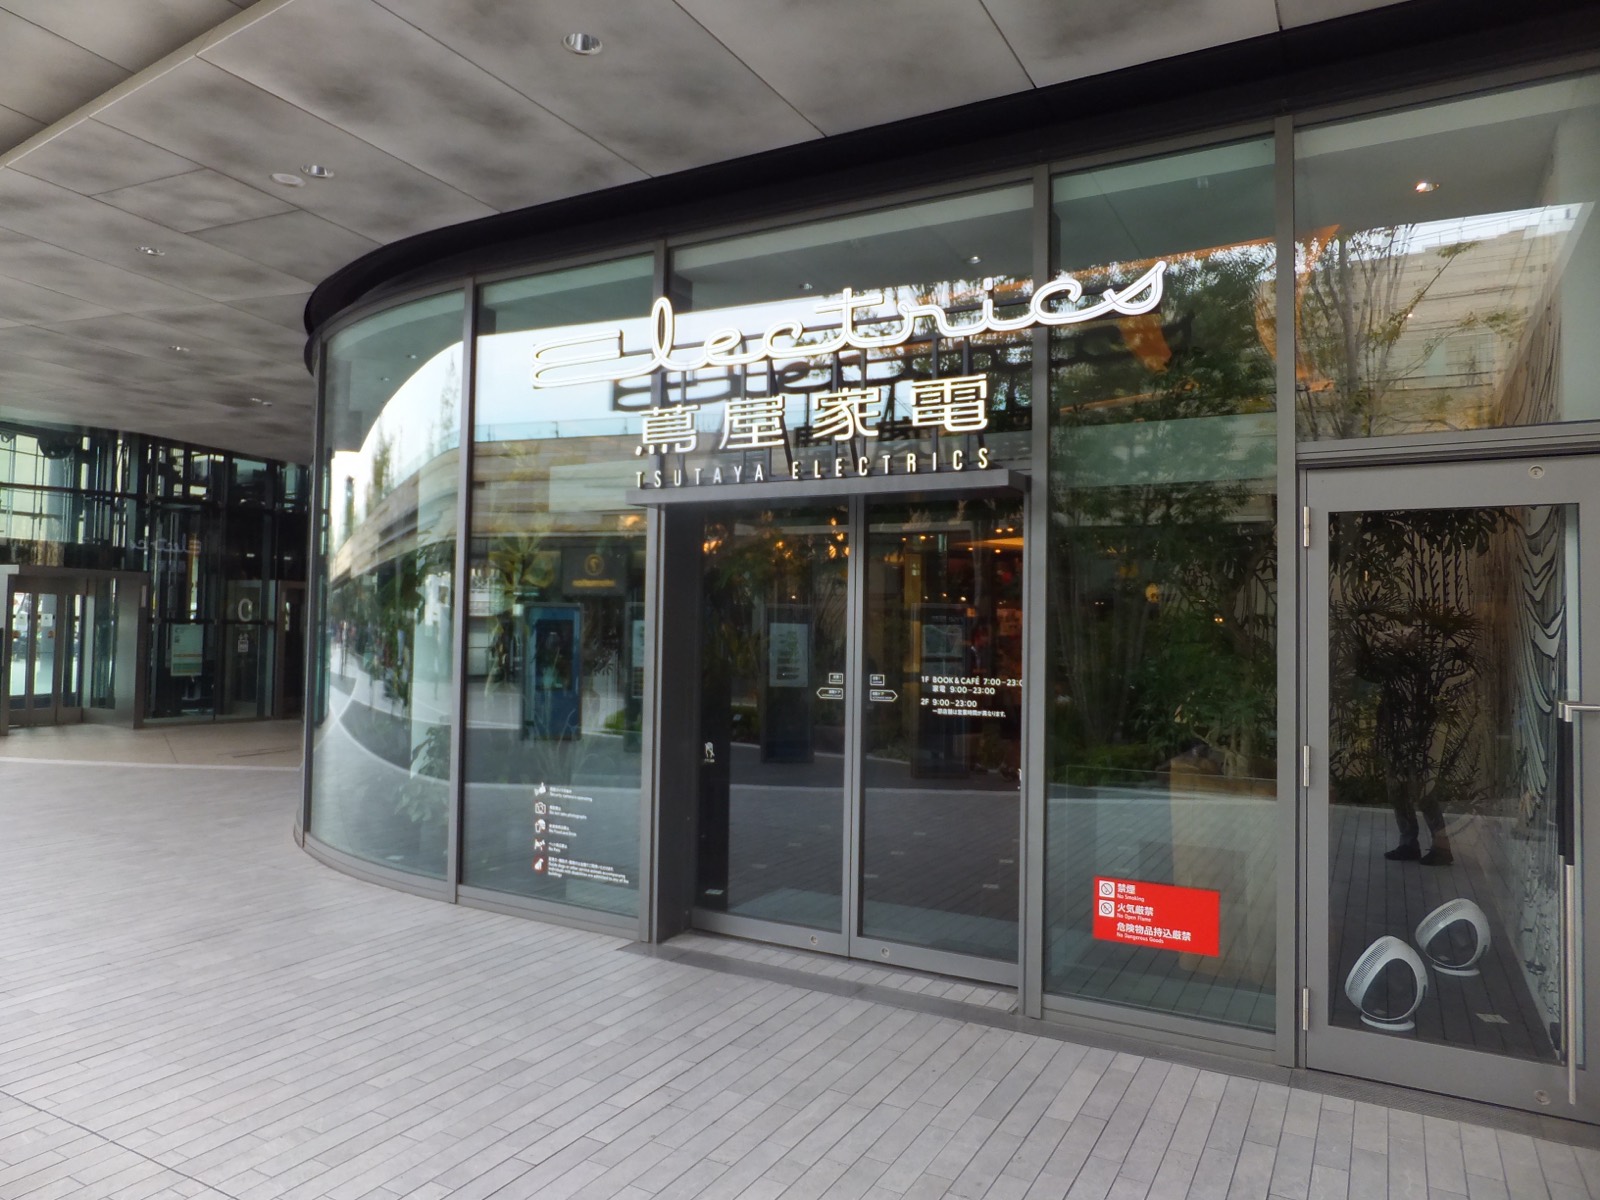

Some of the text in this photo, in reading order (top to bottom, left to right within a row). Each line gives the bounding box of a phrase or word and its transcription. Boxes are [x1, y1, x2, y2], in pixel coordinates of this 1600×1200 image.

[529, 259, 1168, 390] Electrics
[634, 372, 989, 456] 蔦屋家電
[635, 447, 991, 489] TSUTAYA ELECTRICS
[921, 675, 930, 684] 1F
[932, 676, 954, 684] BOOK
[920, 698, 930, 706] 2F
[1117, 883, 1136, 895] 禁煙
[1124, 894, 1145, 903] Smoking
[1117, 903, 1154, 917] 火気厳禁
[1116, 922, 1192, 942] 危険物品持込厳禁
